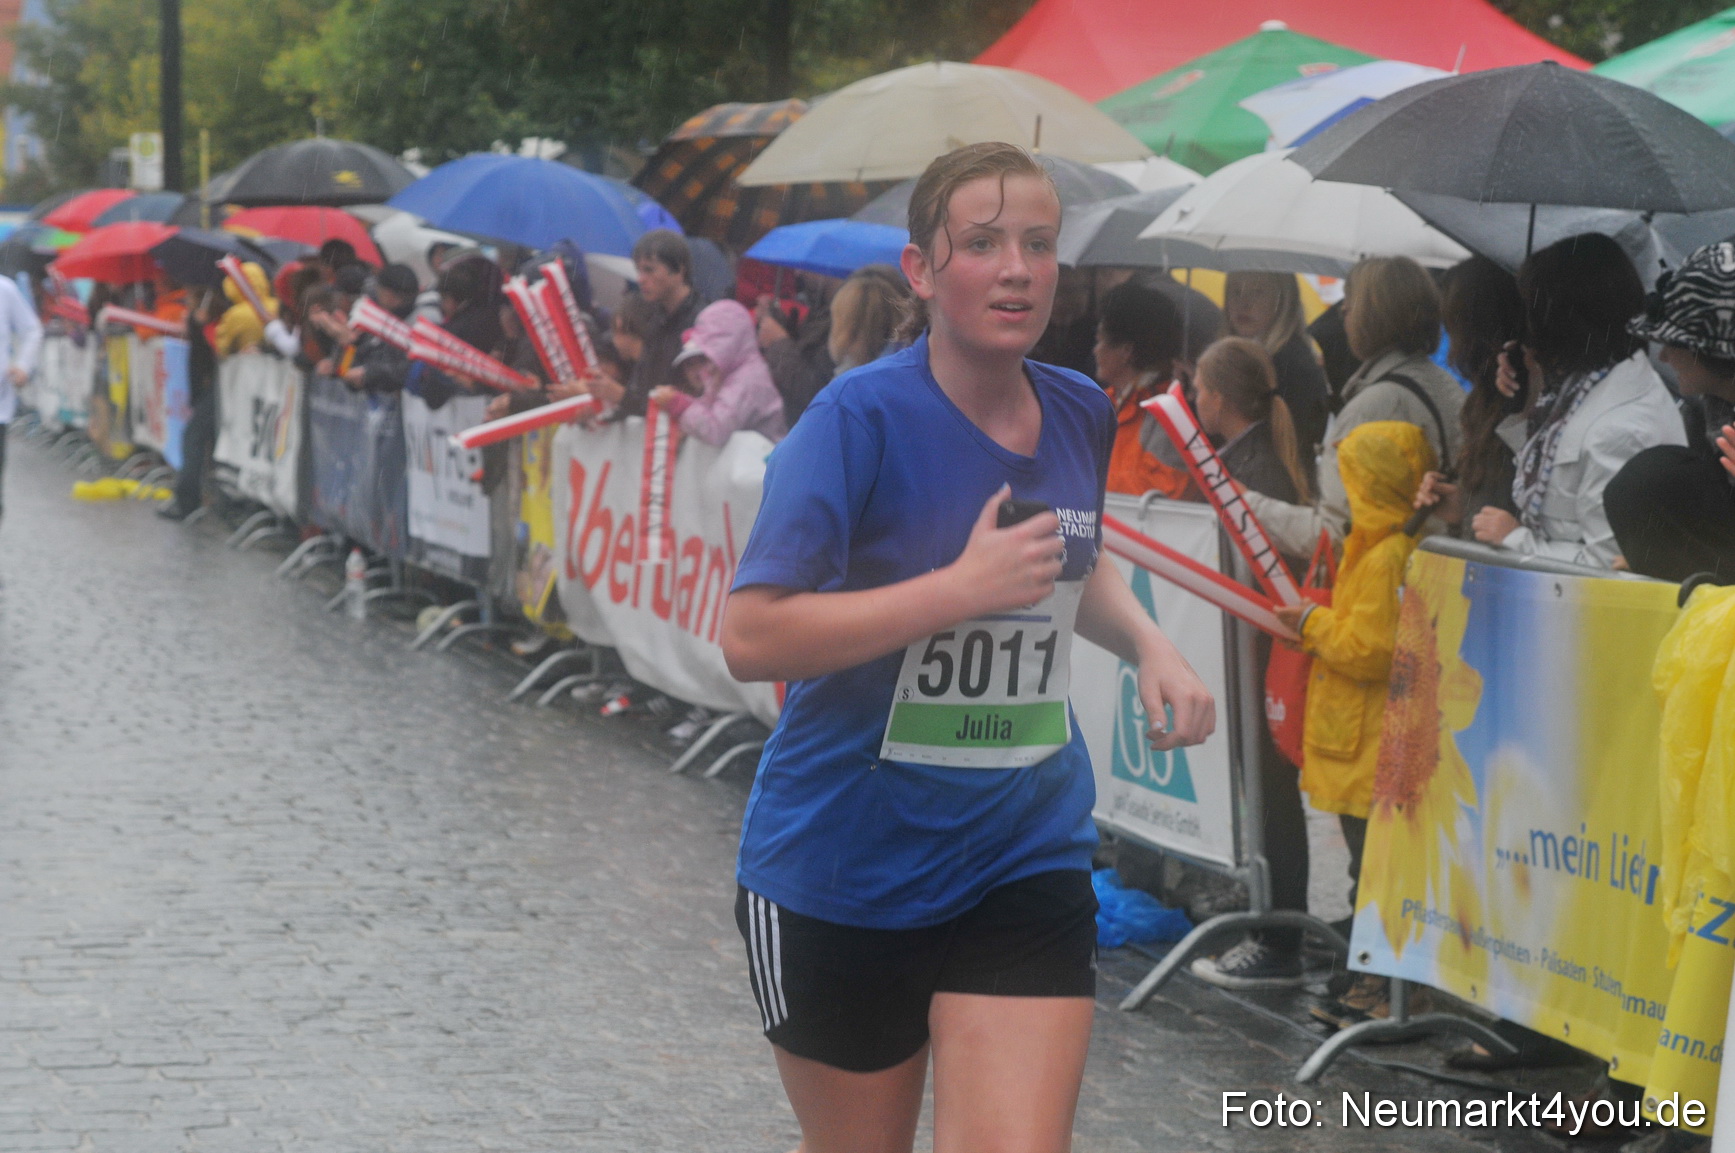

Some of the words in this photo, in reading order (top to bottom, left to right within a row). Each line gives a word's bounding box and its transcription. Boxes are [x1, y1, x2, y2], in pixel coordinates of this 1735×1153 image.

[1185, 429, 1286, 579] AUSTRIA
[917, 629, 1058, 699] 5011
[955, 714, 1013, 741] Julia
